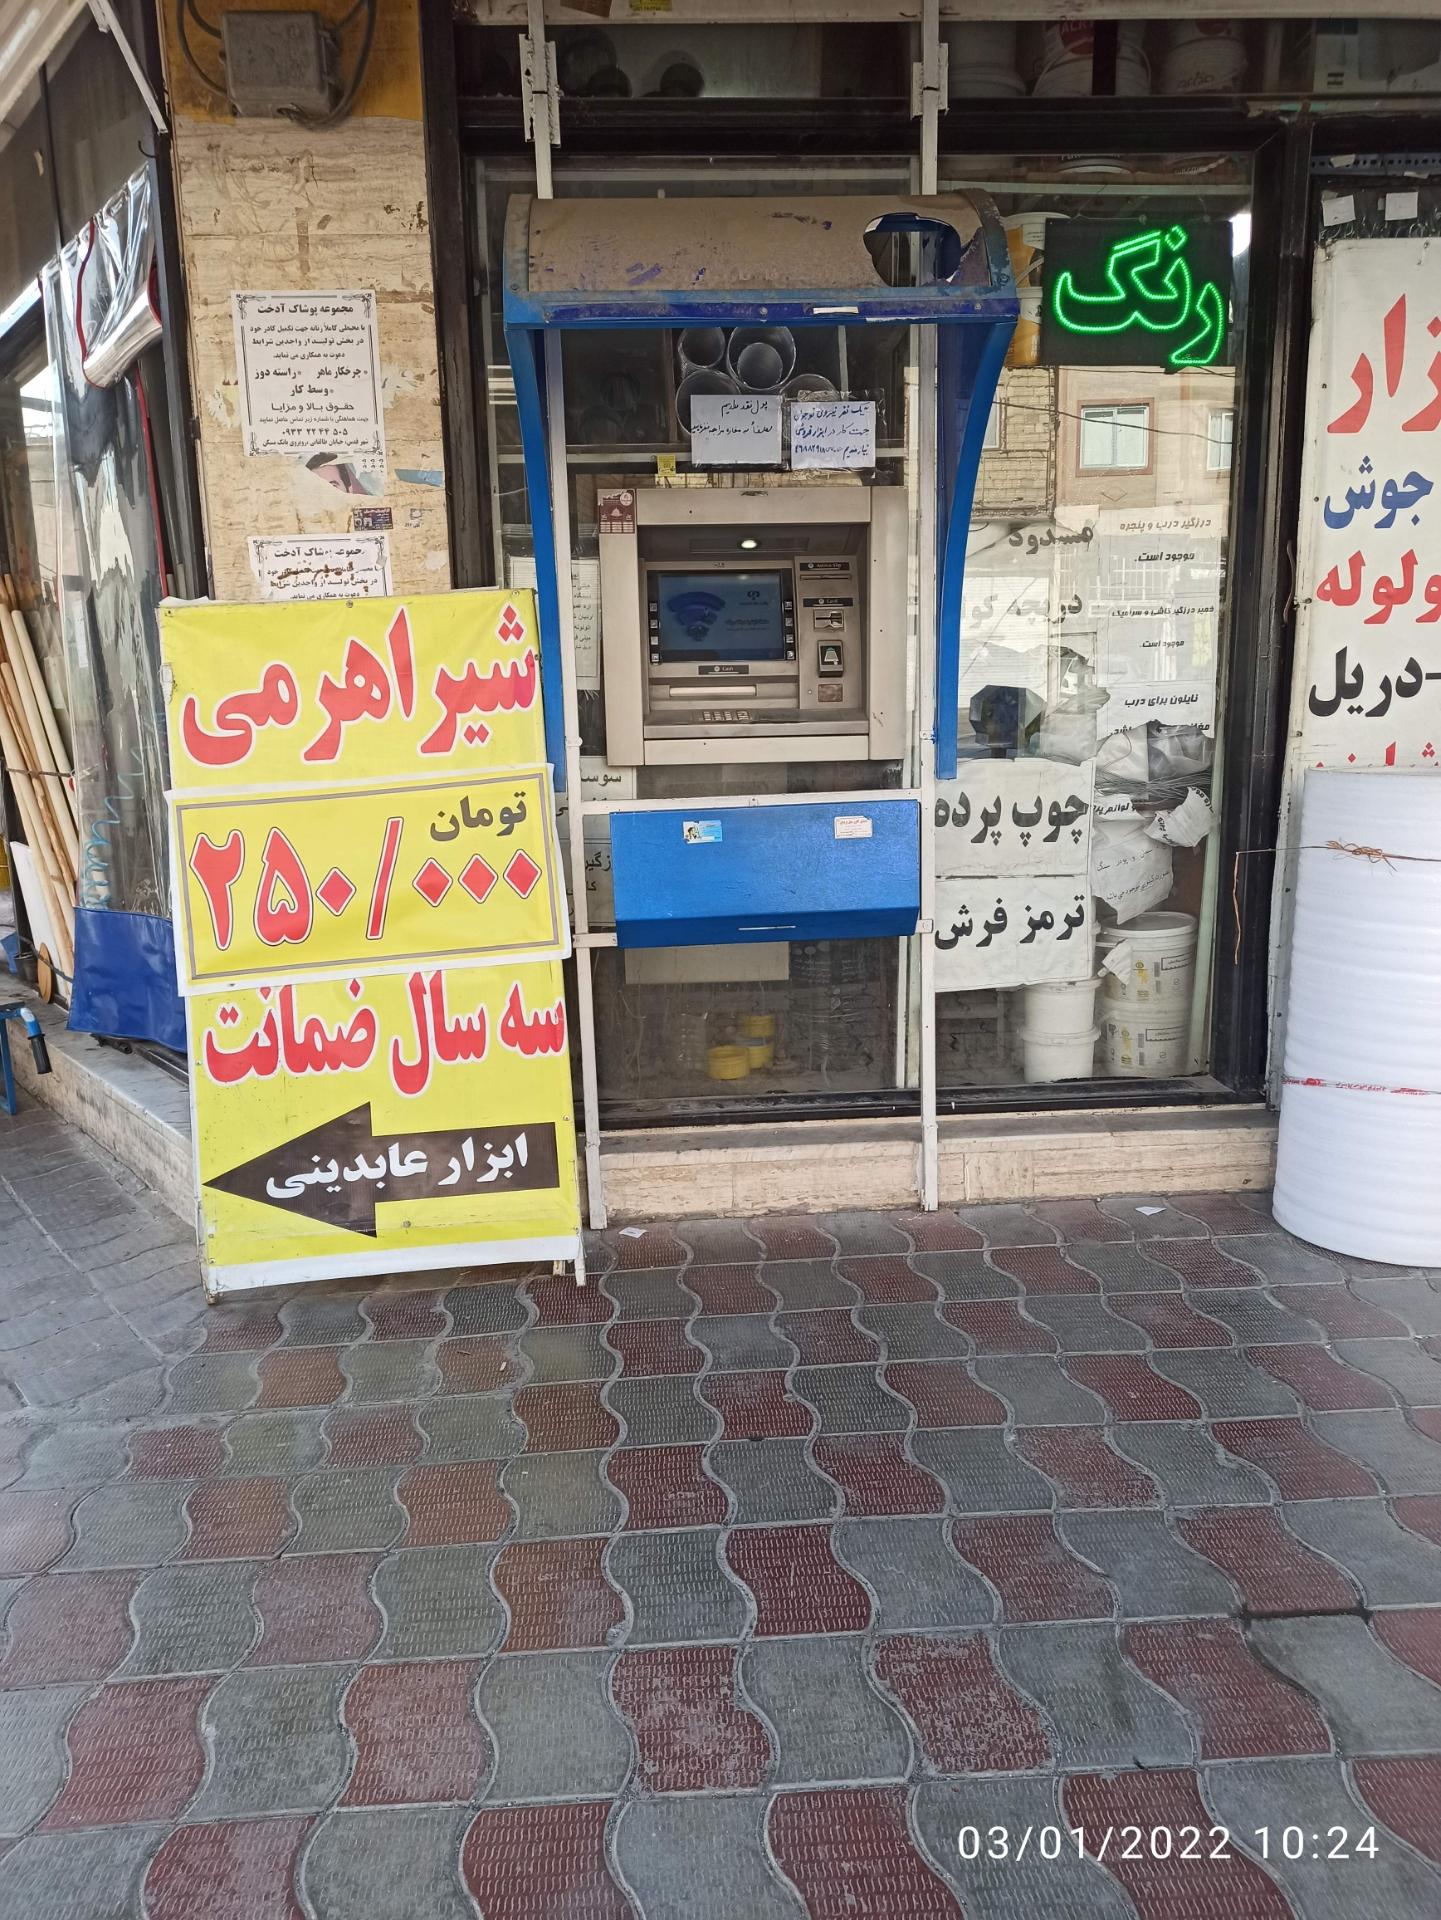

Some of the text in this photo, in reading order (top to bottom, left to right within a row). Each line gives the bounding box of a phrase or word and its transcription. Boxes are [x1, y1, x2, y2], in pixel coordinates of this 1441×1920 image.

[1056, 226, 1223, 364] رنگ
[289, 304, 317, 316] پوشاک
[320, 304, 353, 315] مجموعه
[252, 338, 274, 346] شرایط
[255, 366, 362, 379] چرخکار ماهر راسته دوز
[290, 384, 328, 396] وسط کار
[272, 402, 296, 412] مزایا
[306, 402, 323, 412] بالا
[326, 402, 354, 412] حقوق
[740, 400, 752, 410] نقد
[838, 404, 850, 418] نفر
[851, 402, 870, 416] یک
[836, 422, 855, 436] کار
[848, 428, 870, 436] جهت
[1324, 456, 1433, 529] جوش
[1120, 517, 1212, 532] درزگیر درب و پنجره
[1008, 526, 1093, 554] مسدود
[1165, 552, 1195, 562] موجود
[182, 604, 538, 765] شیر اهرمی
[1124, 694, 1198, 708] نایلون برای درب
[430, 791, 527, 841] تومان
[935, 791, 1001, 844] پرده
[189, 817, 542, 951] ۲۵۰/۰۰۰
[935, 894, 1084, 950] ترمز فرش
[206, 970, 564, 1095] سه سال ضمانت
[266, 1132, 528, 1199] ابزار عابدینی
